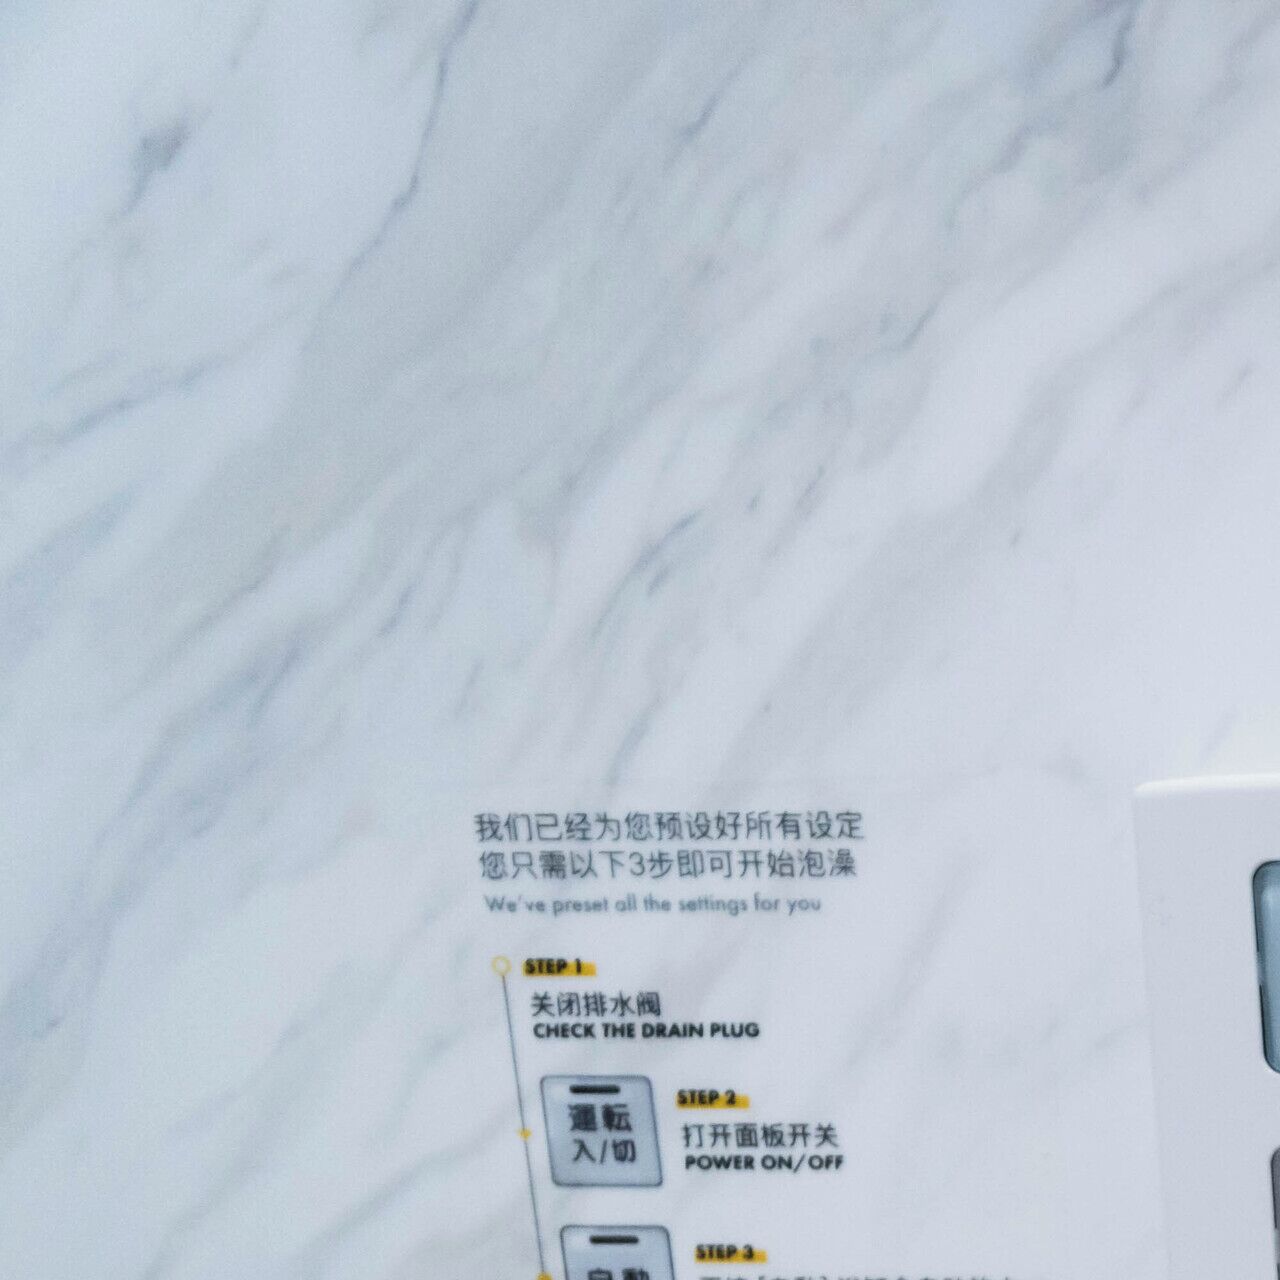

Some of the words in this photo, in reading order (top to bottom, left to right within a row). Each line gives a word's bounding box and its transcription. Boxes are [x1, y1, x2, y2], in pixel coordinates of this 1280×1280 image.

[474, 811, 865, 842] 我们已经为您预设好所有设定
[479, 848, 857, 880] 您只需以下3步即可开始泡澡
[552, 896, 609, 916] preset
[615, 894, 637, 912] all
[643, 894, 671, 912] the
[678, 894, 748, 916] settings
[753, 894, 780, 912] for
[787, 898, 822, 915] you
[525, 958, 568, 974] STEP
[574, 958, 582, 974] 1
[531, 991, 661, 1017] 关闭排水阀
[533, 1023, 596, 1038] CHECK
[602, 1023, 635, 1038] THE
[641, 1023, 704, 1038] DRAIN
[710, 1022, 760, 1038] PLUG
[677, 1089, 719, 1105] STEP
[725, 1089, 736, 1105] 2
[682, 1122, 839, 1148] 打开面板开关
[685, 1154, 754, 1170] POWER
[761, 1153, 844, 1173] ON/OFF
[696, 1244, 738, 1260] STEP
[744, 1244, 755, 1260] 3
